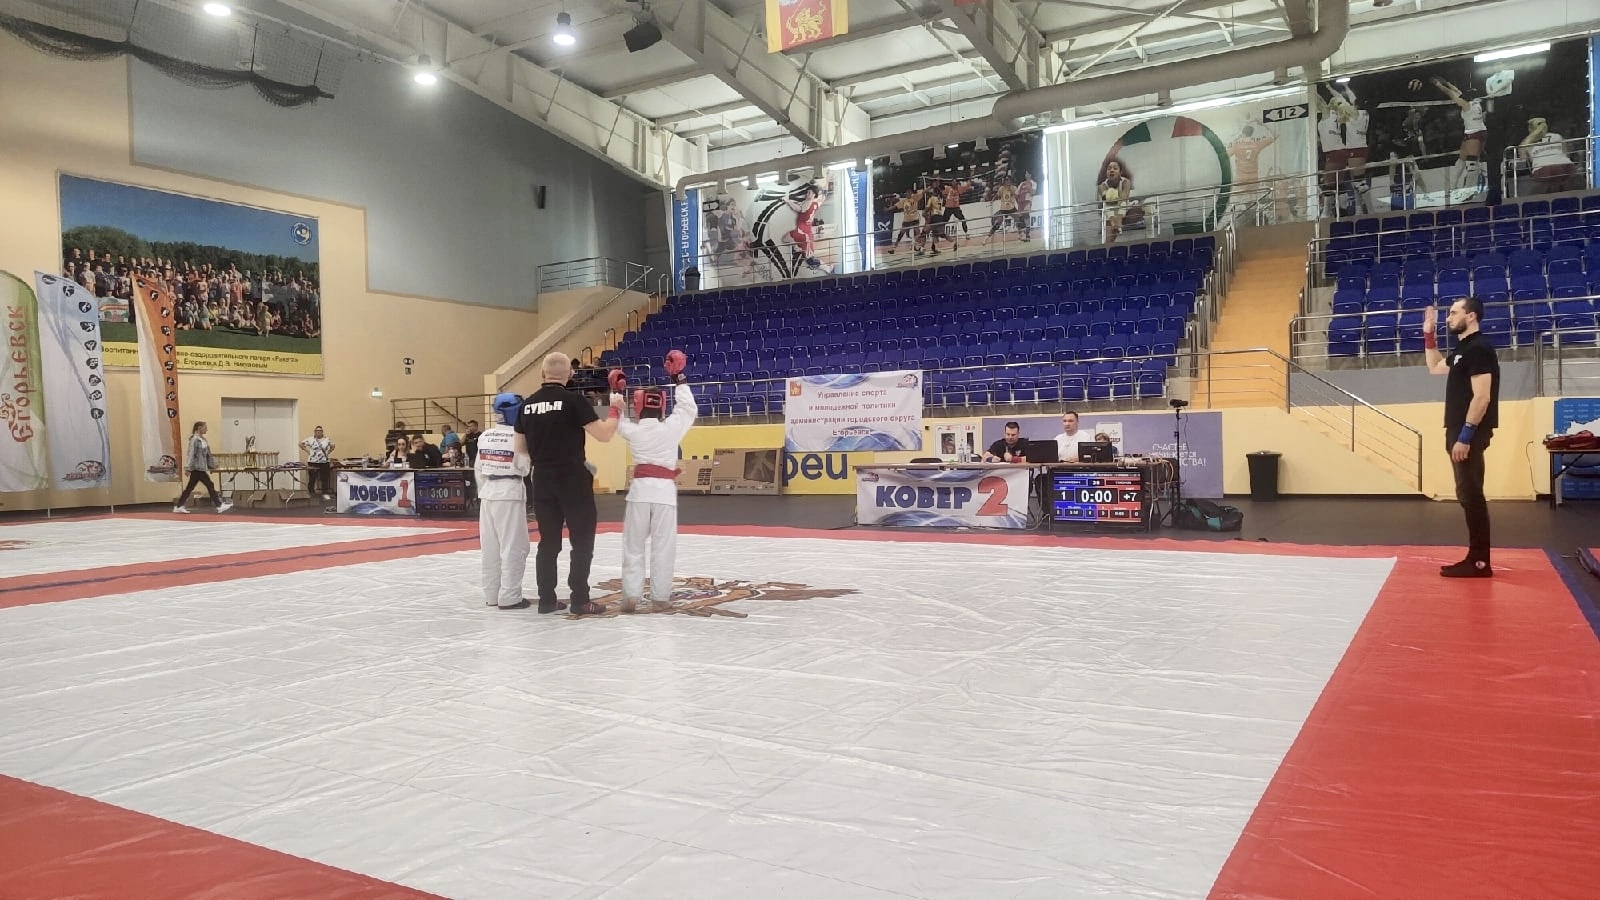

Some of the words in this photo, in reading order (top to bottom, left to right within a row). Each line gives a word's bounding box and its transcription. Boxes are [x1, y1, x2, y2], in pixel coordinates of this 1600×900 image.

[1277, 110, 1282, 118] 1
[1289, 108, 1296, 116] 2
[817, 391, 859, 399] Управление
[861, 389, 887, 397] спорта
[523, 400, 563, 415] СУДЬЯ
[861, 402, 896, 410] политики
[889, 415, 915, 423] округа
[349, 485, 396, 502] КОВЕР
[397, 480, 412, 508] 1
[875, 485, 972, 509] КОВЕР
[975, 476, 1009, 516] 2
[1060, 491, 1066, 500] 1
[1081, 489, 1112, 503] 0:00
[1123, 492, 1138, 501] +7
